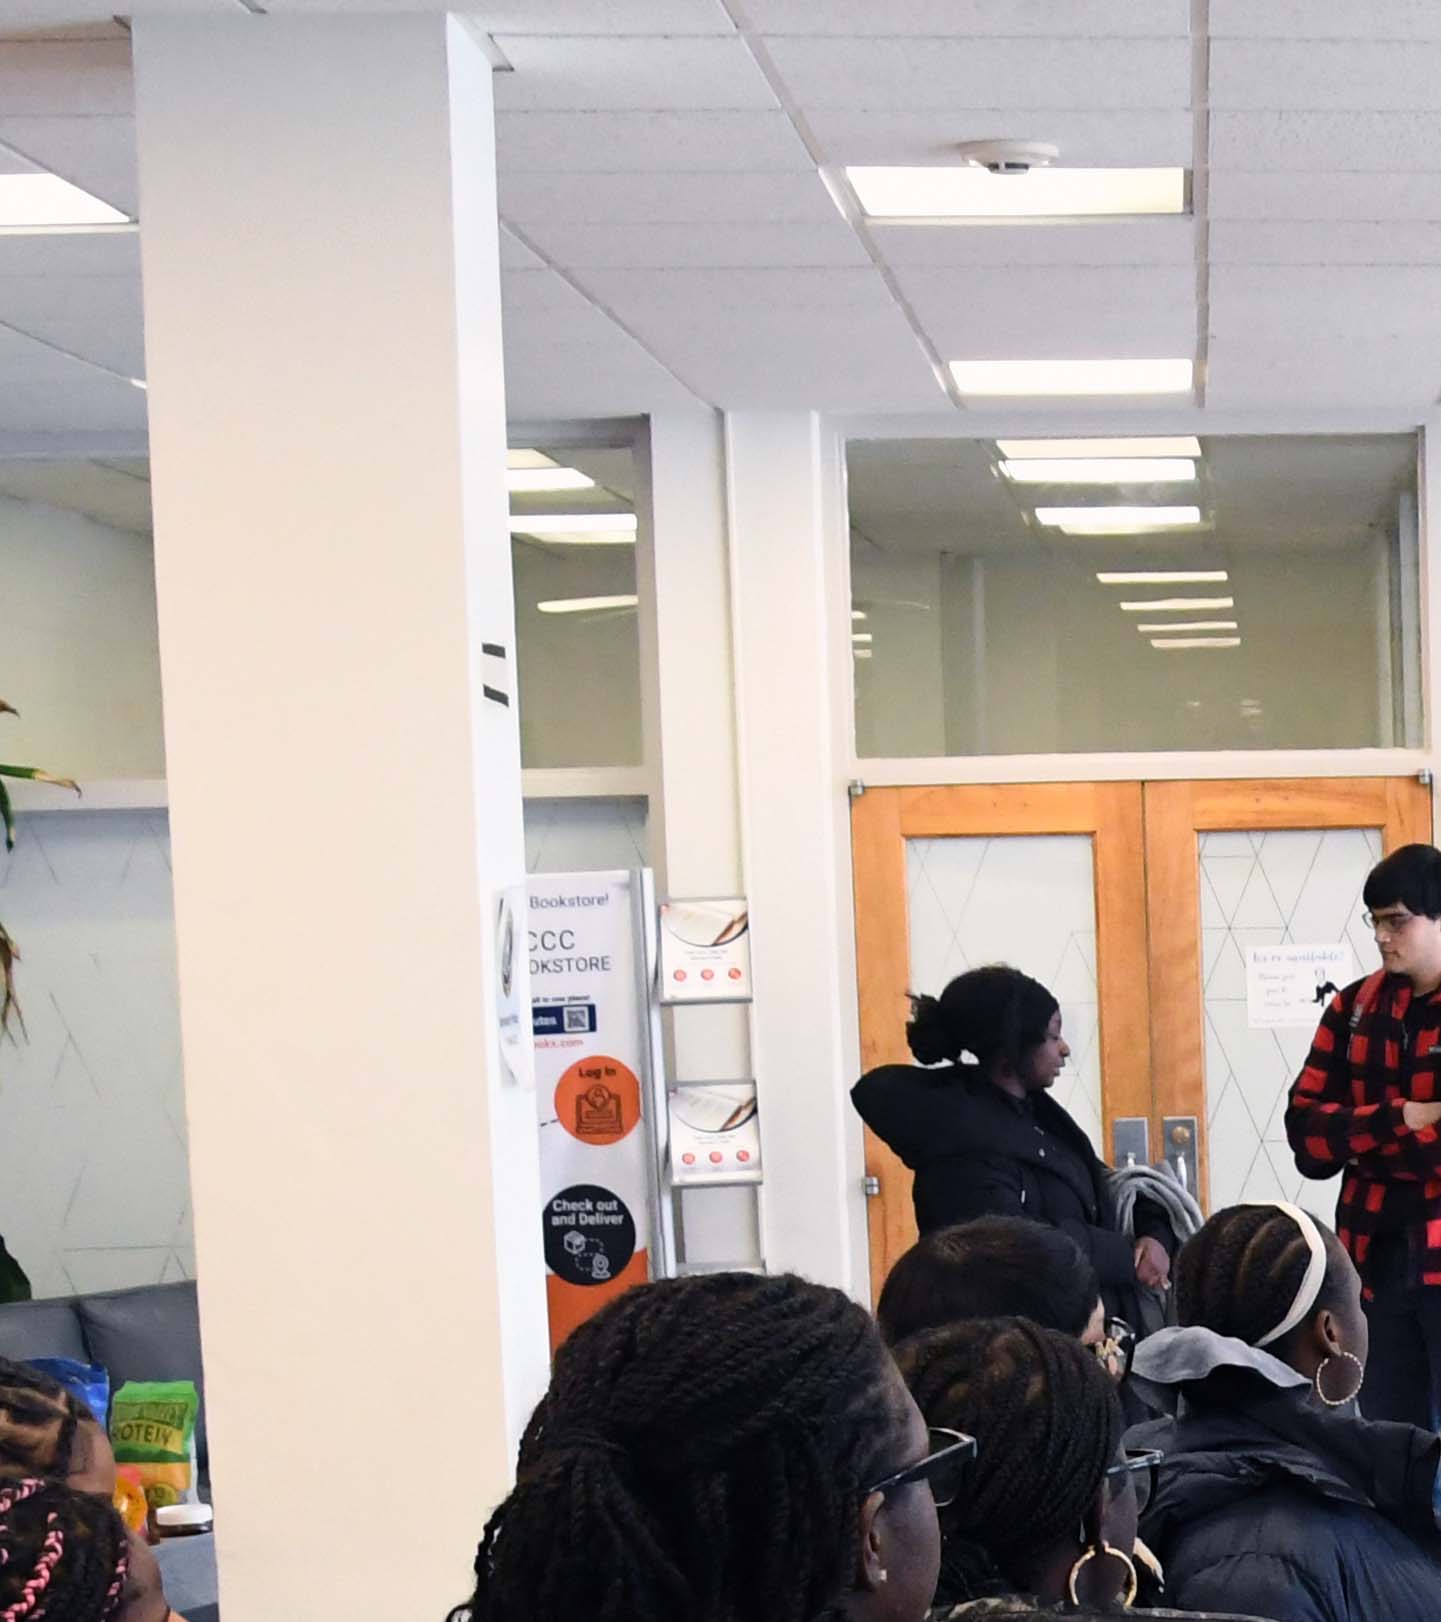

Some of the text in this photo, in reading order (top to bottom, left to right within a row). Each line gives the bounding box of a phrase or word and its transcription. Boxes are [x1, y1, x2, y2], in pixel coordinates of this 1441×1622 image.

[529, 893, 609, 910] Bookstore!
[578, 1066, 603, 1080] Log
[552, 1198, 618, 1212] Check out
[551, 1212, 625, 1226] and Deliver
